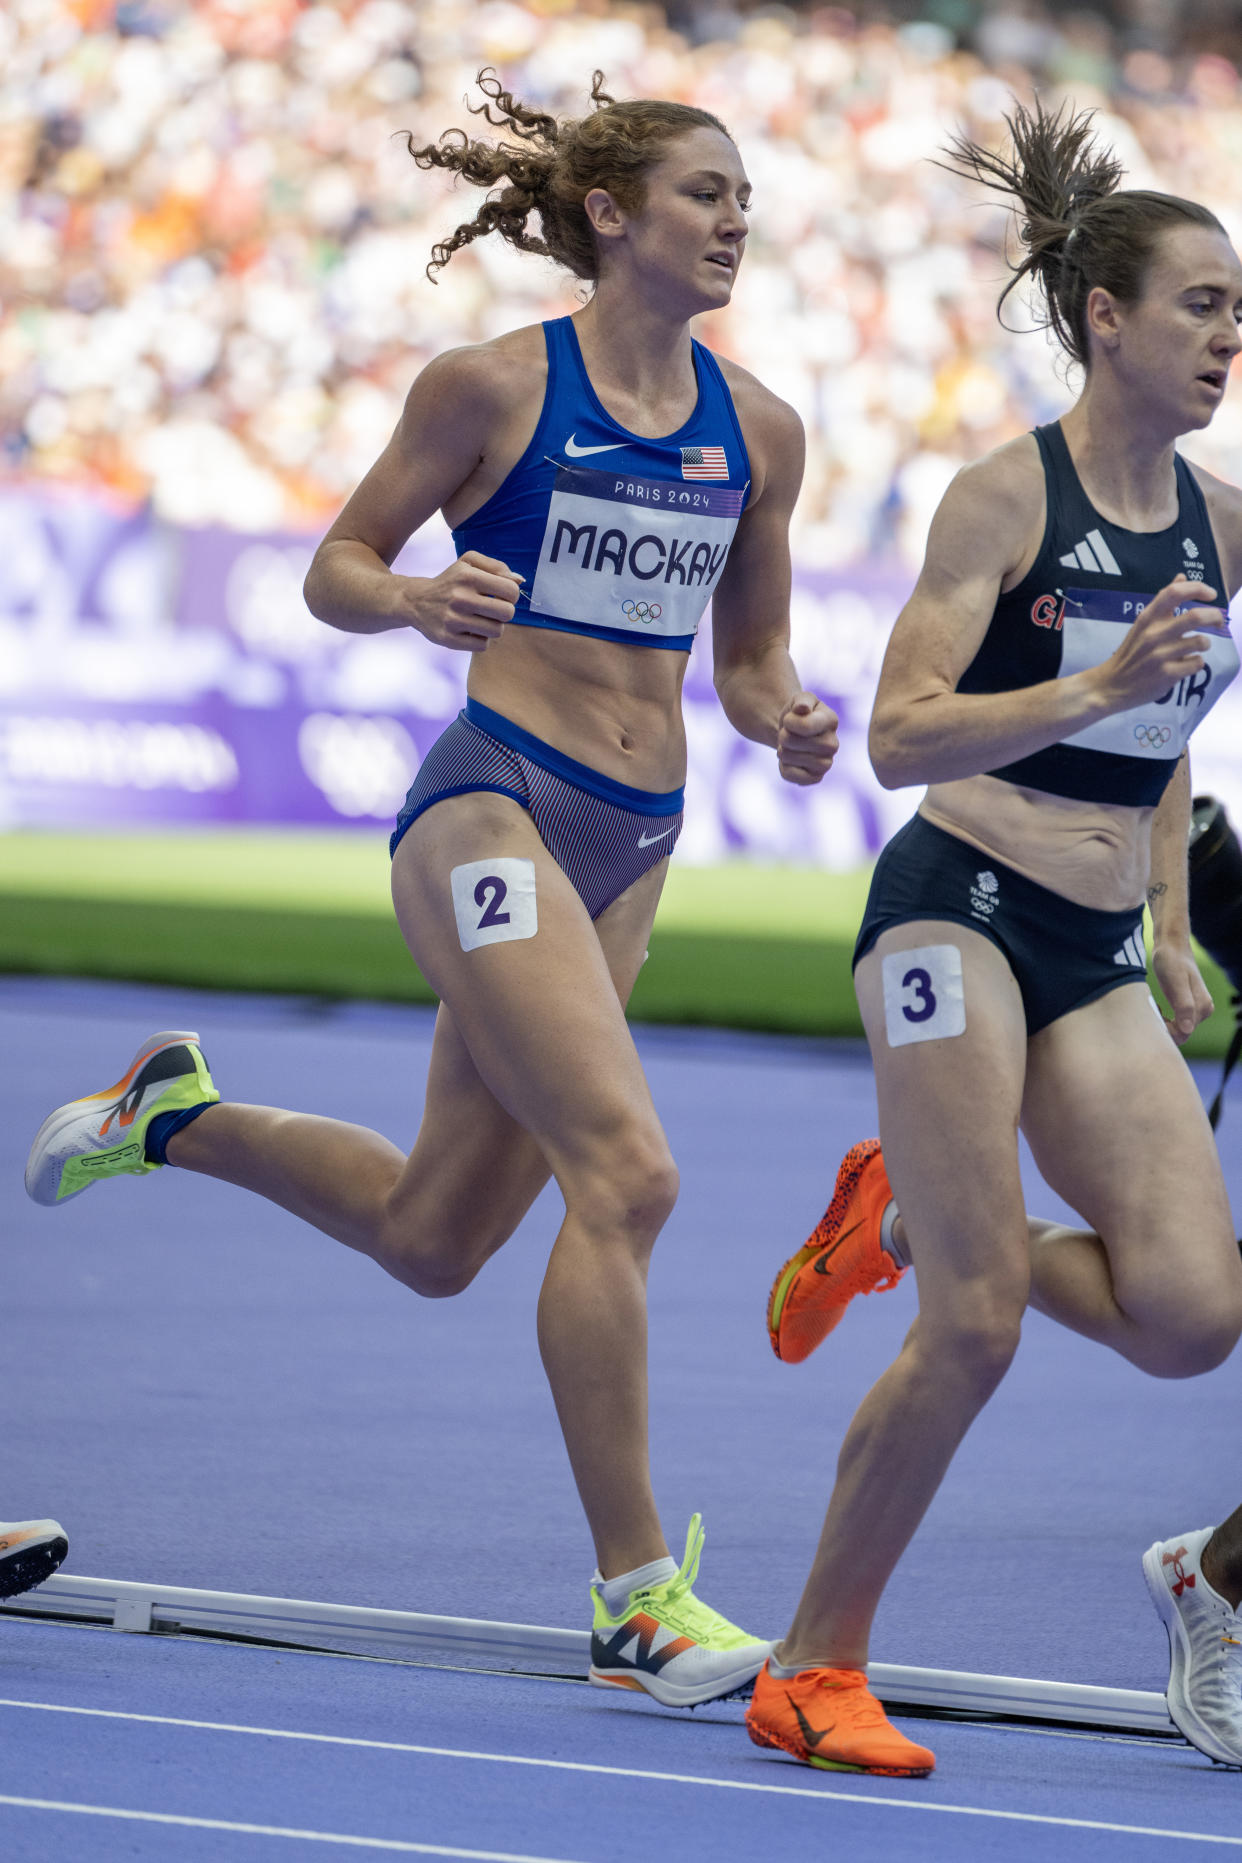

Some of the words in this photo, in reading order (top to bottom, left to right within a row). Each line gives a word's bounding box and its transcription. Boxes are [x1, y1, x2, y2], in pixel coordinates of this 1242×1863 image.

[614, 481, 660, 501] PARIS
[667, 490, 709, 508] 2024
[549, 519, 728, 586] MACKAY
[474, 875, 511, 930] 2
[902, 967, 937, 1024] 3
